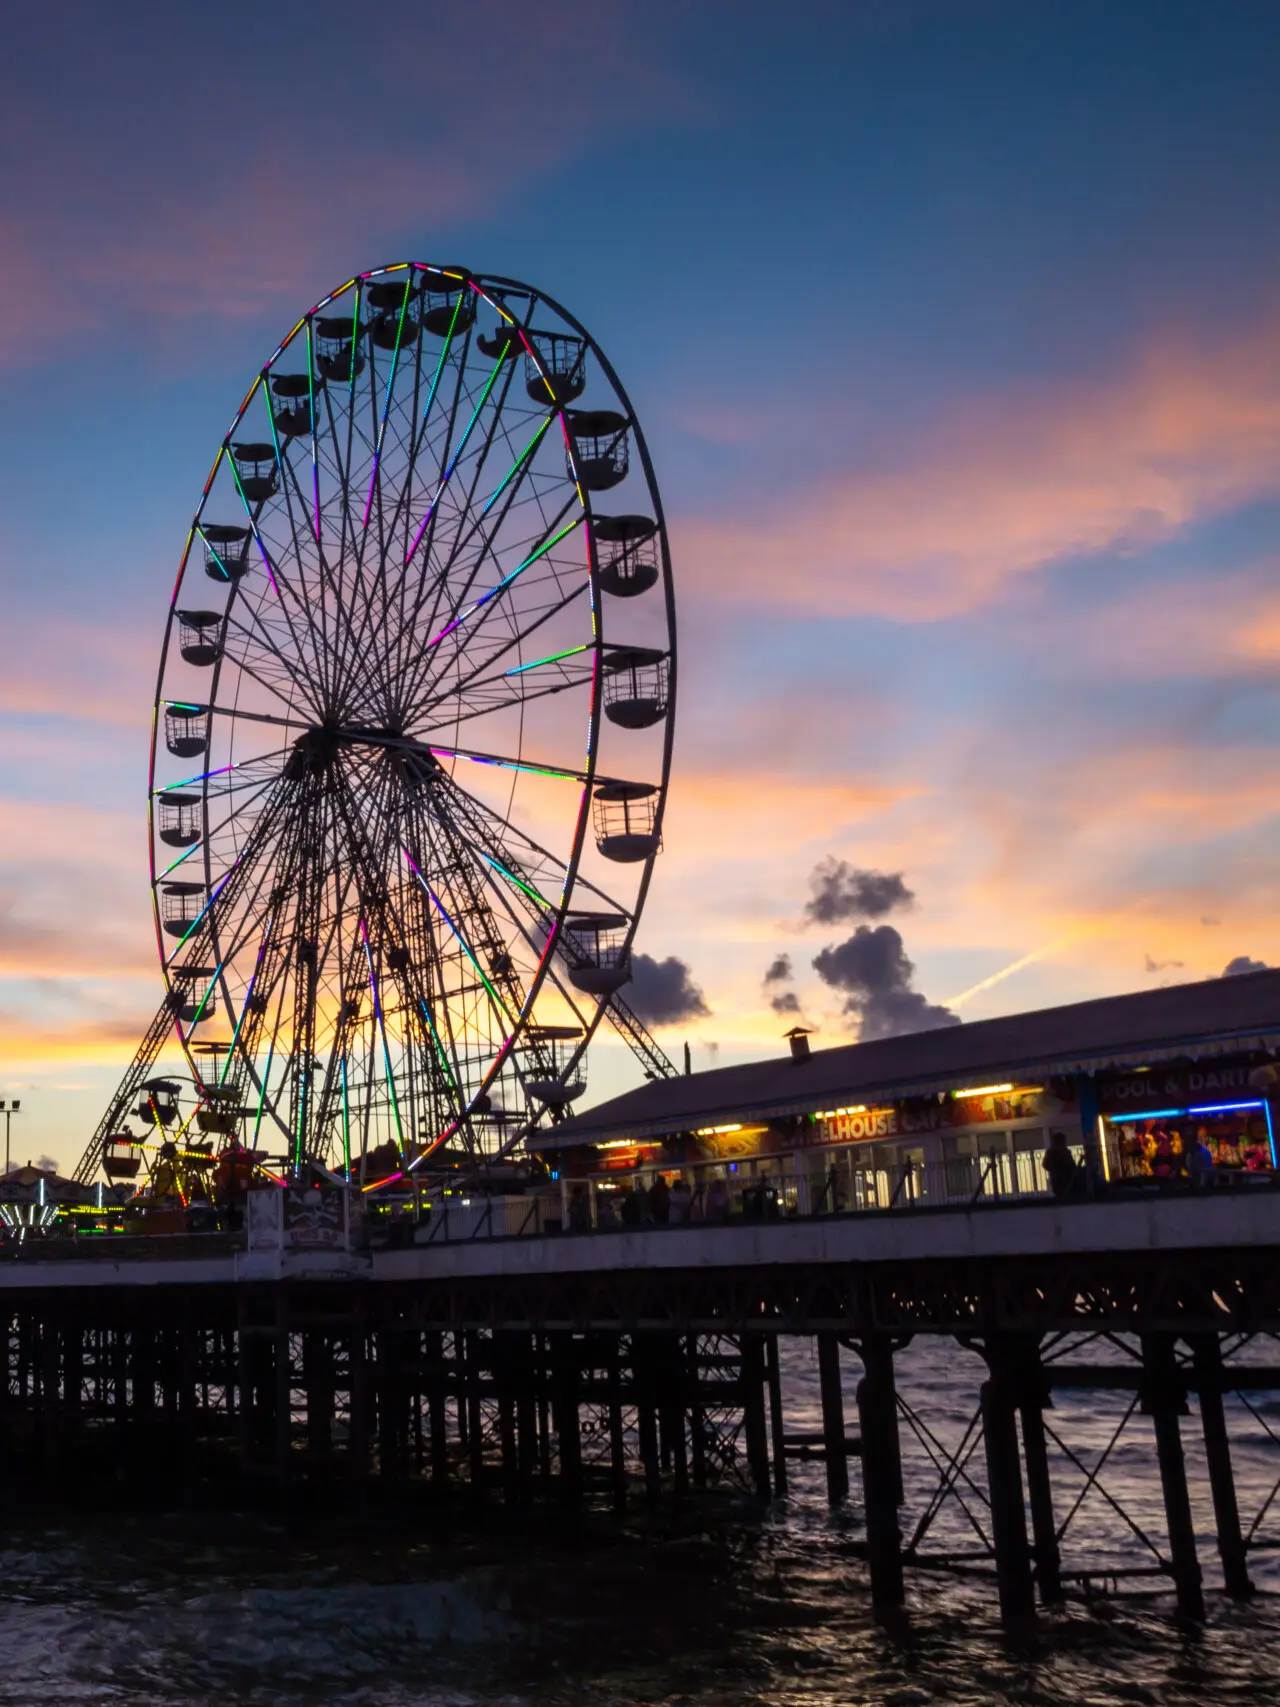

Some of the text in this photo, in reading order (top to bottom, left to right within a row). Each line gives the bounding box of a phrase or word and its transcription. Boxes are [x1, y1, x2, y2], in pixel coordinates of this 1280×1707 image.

[1101, 1068, 1251, 1101] POOL & DART
